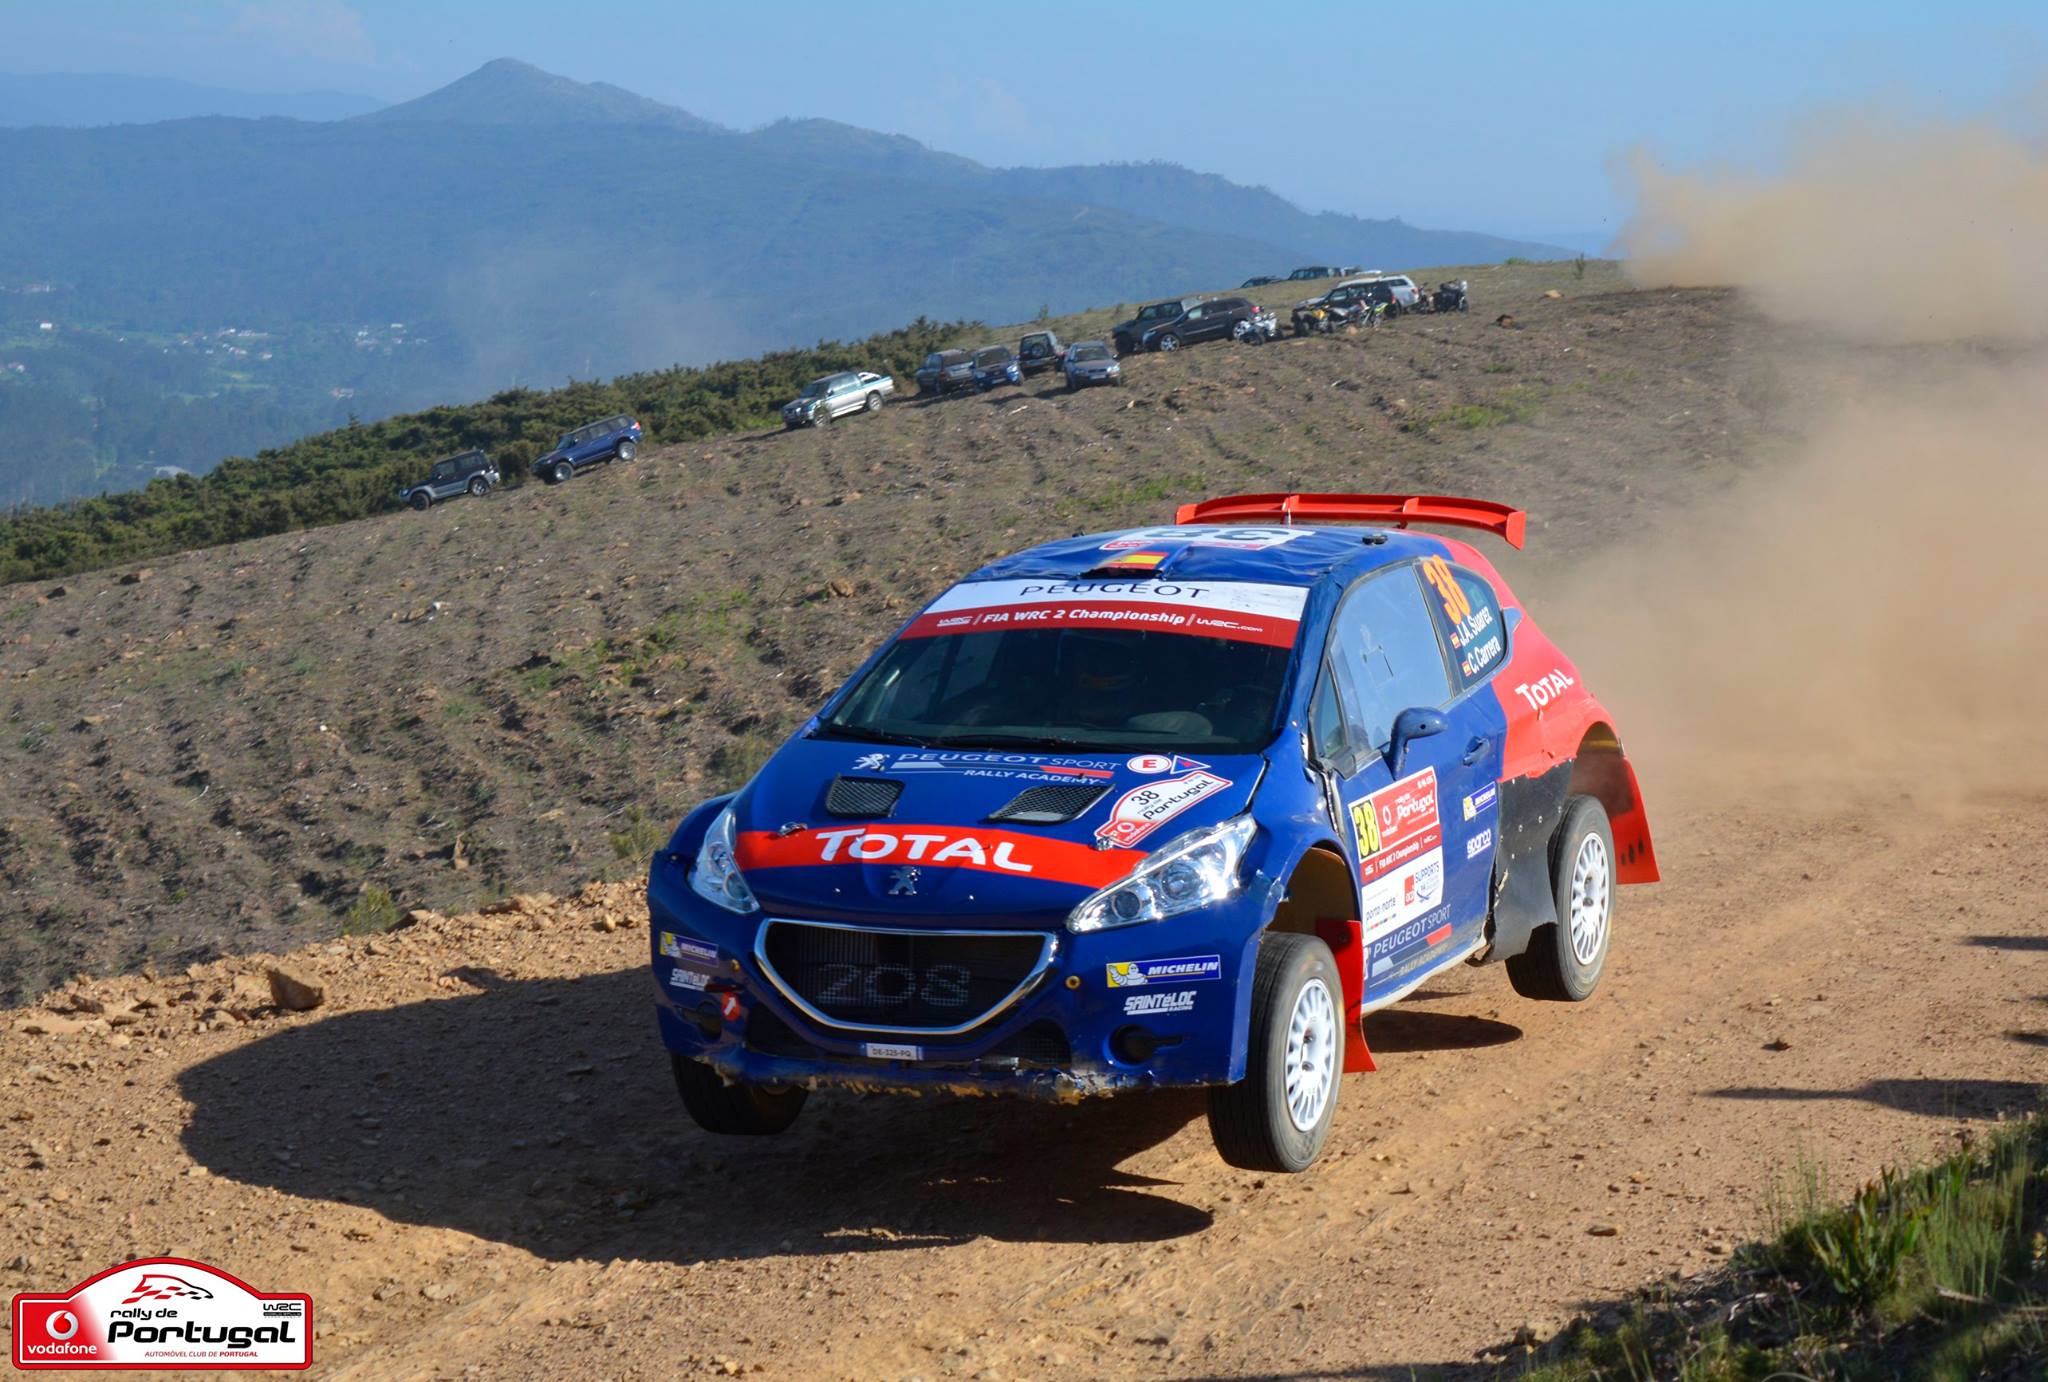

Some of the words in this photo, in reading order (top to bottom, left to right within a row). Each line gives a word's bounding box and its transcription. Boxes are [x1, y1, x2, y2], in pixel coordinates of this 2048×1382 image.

[1020, 583, 1210, 599] PEUGEOT
[1423, 555, 1471, 625] 38
[982, 613, 1009, 623] FIA
[1014, 610, 1050, 621] WRC
[1053, 610, 1066, 619] 2
[1068, 609, 1185, 625] Championship
[1468, 652, 1478, 674] C.
[1515, 669, 1574, 710] TOTAL
[898, 753, 1048, 764] PEUGEOT
[1050, 758, 1120, 771] SPORT
[1142, 759, 1157, 768] E
[963, 769, 1014, 778] RALLY
[1015, 773, 1101, 785] ACADEMY
[1131, 790, 1159, 806] 38
[1143, 779, 1214, 820] Portugal
[1397, 790, 1434, 819] Portugal
[1353, 802, 1380, 856] 38
[816, 828, 1033, 873] TOTAL
[1373, 920, 1426, 958] PEUGEOT
[1427, 904, 1451, 930] SPORT
[1148, 962, 1218, 975] MICHELIN
[816, 964, 970, 1007] 208
